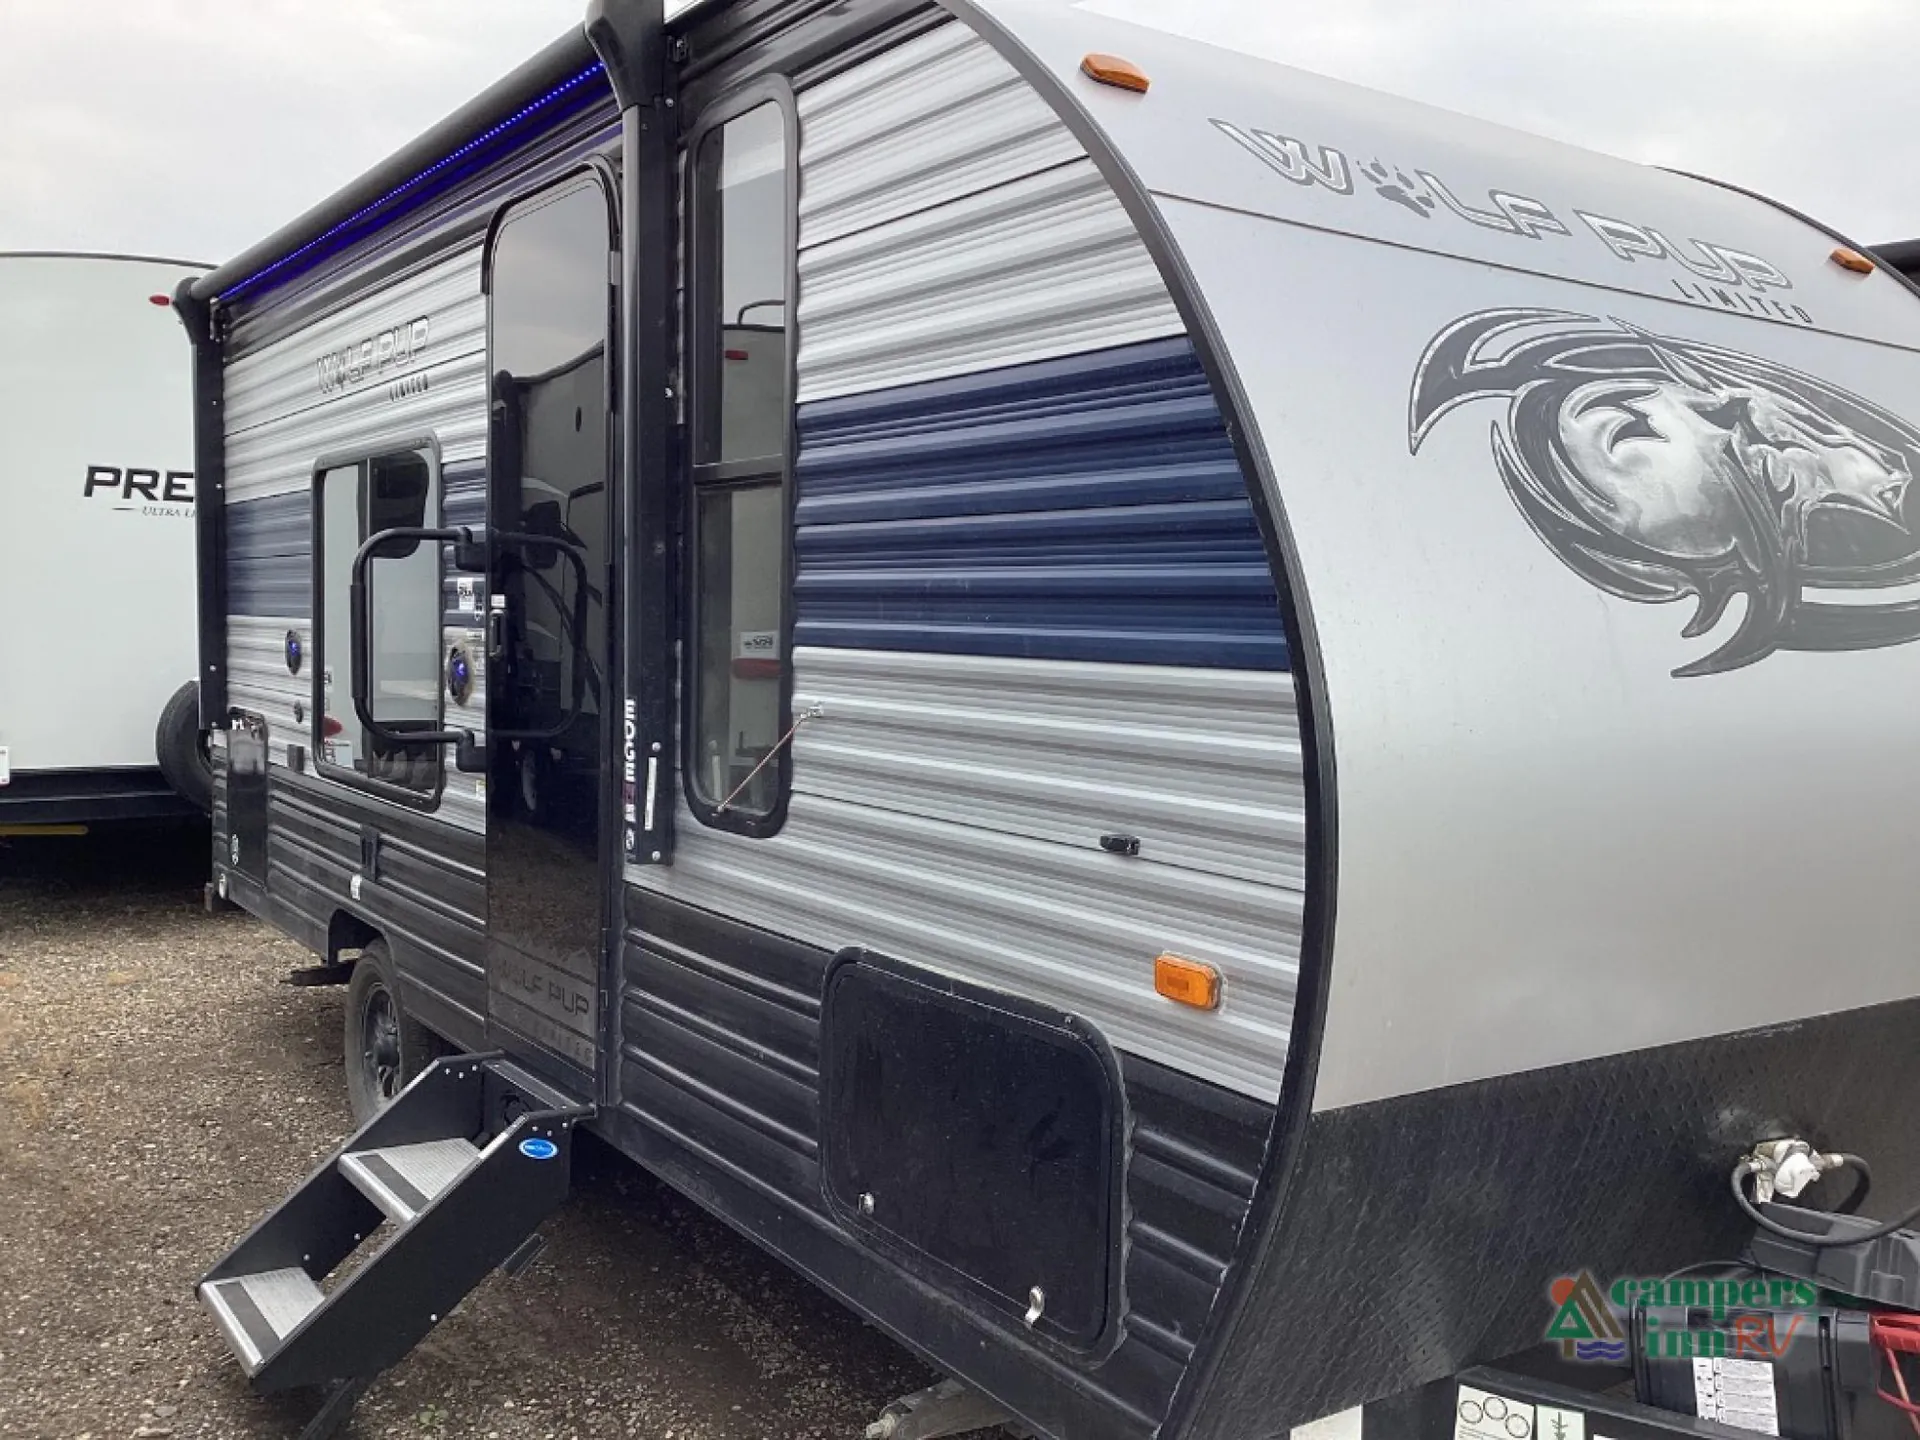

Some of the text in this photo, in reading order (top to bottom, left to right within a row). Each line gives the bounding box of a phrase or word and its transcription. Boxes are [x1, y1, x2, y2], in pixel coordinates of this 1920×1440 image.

[1572, 207, 1793, 293] PUP
[1671, 278, 1813, 325] LIMITED
[376, 314, 429, 369] PUP
[548, 980, 590, 1016] PUP
